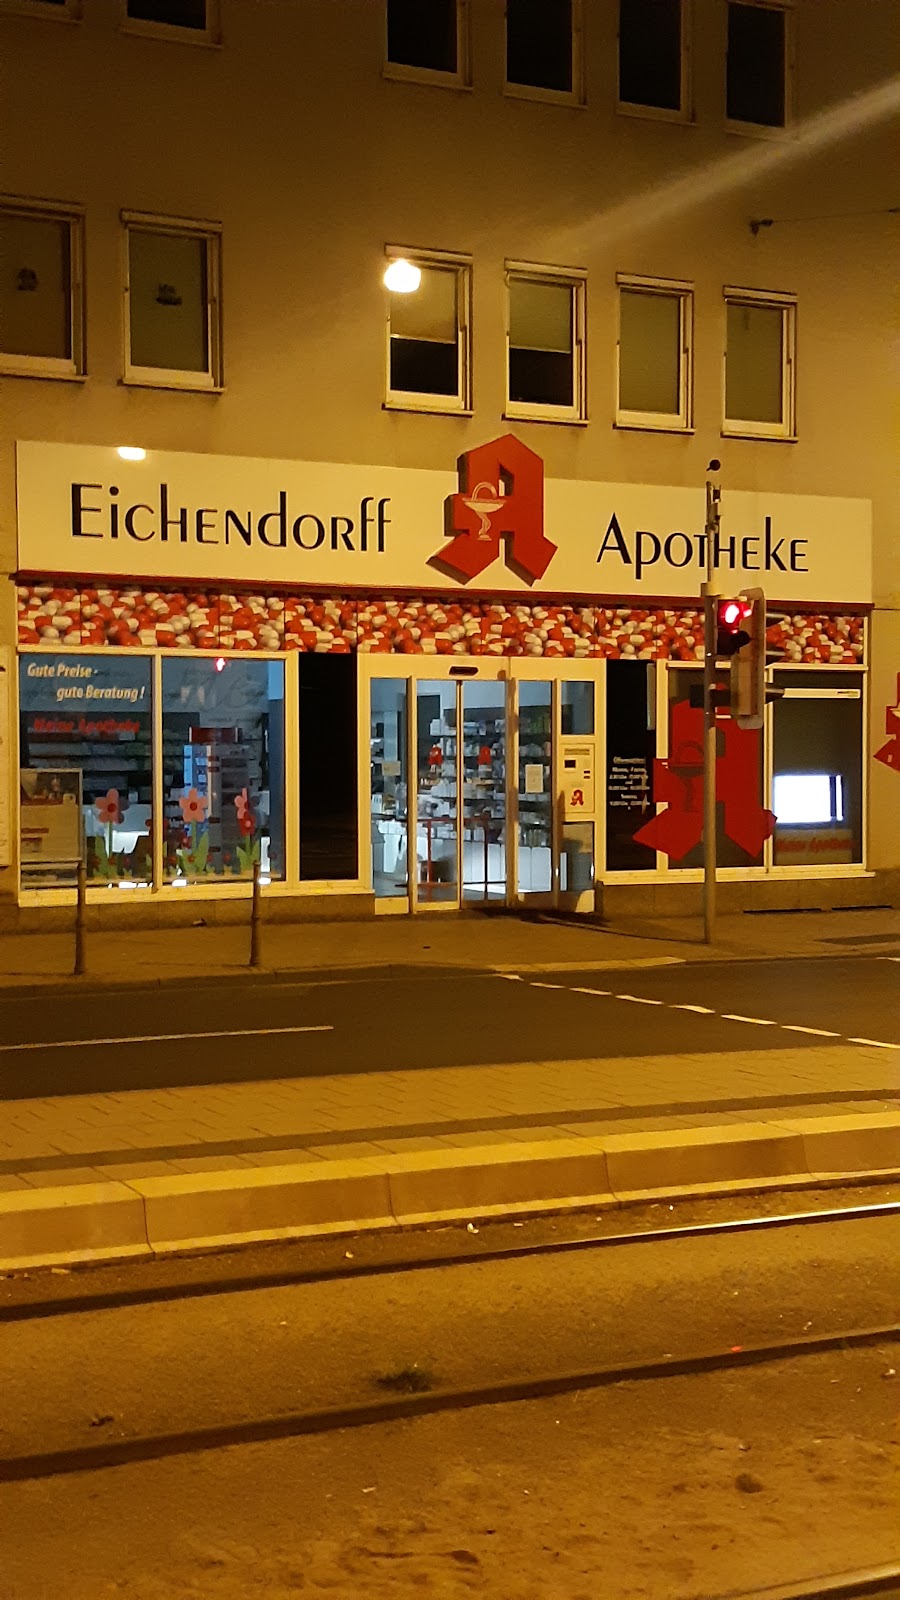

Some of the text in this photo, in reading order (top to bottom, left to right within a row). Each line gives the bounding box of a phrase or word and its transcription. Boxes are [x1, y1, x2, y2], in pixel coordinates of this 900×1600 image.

[27, 663, 55, 677] Gute
[57, 663, 92, 678] Preise
[57, 686, 84, 702] gute
